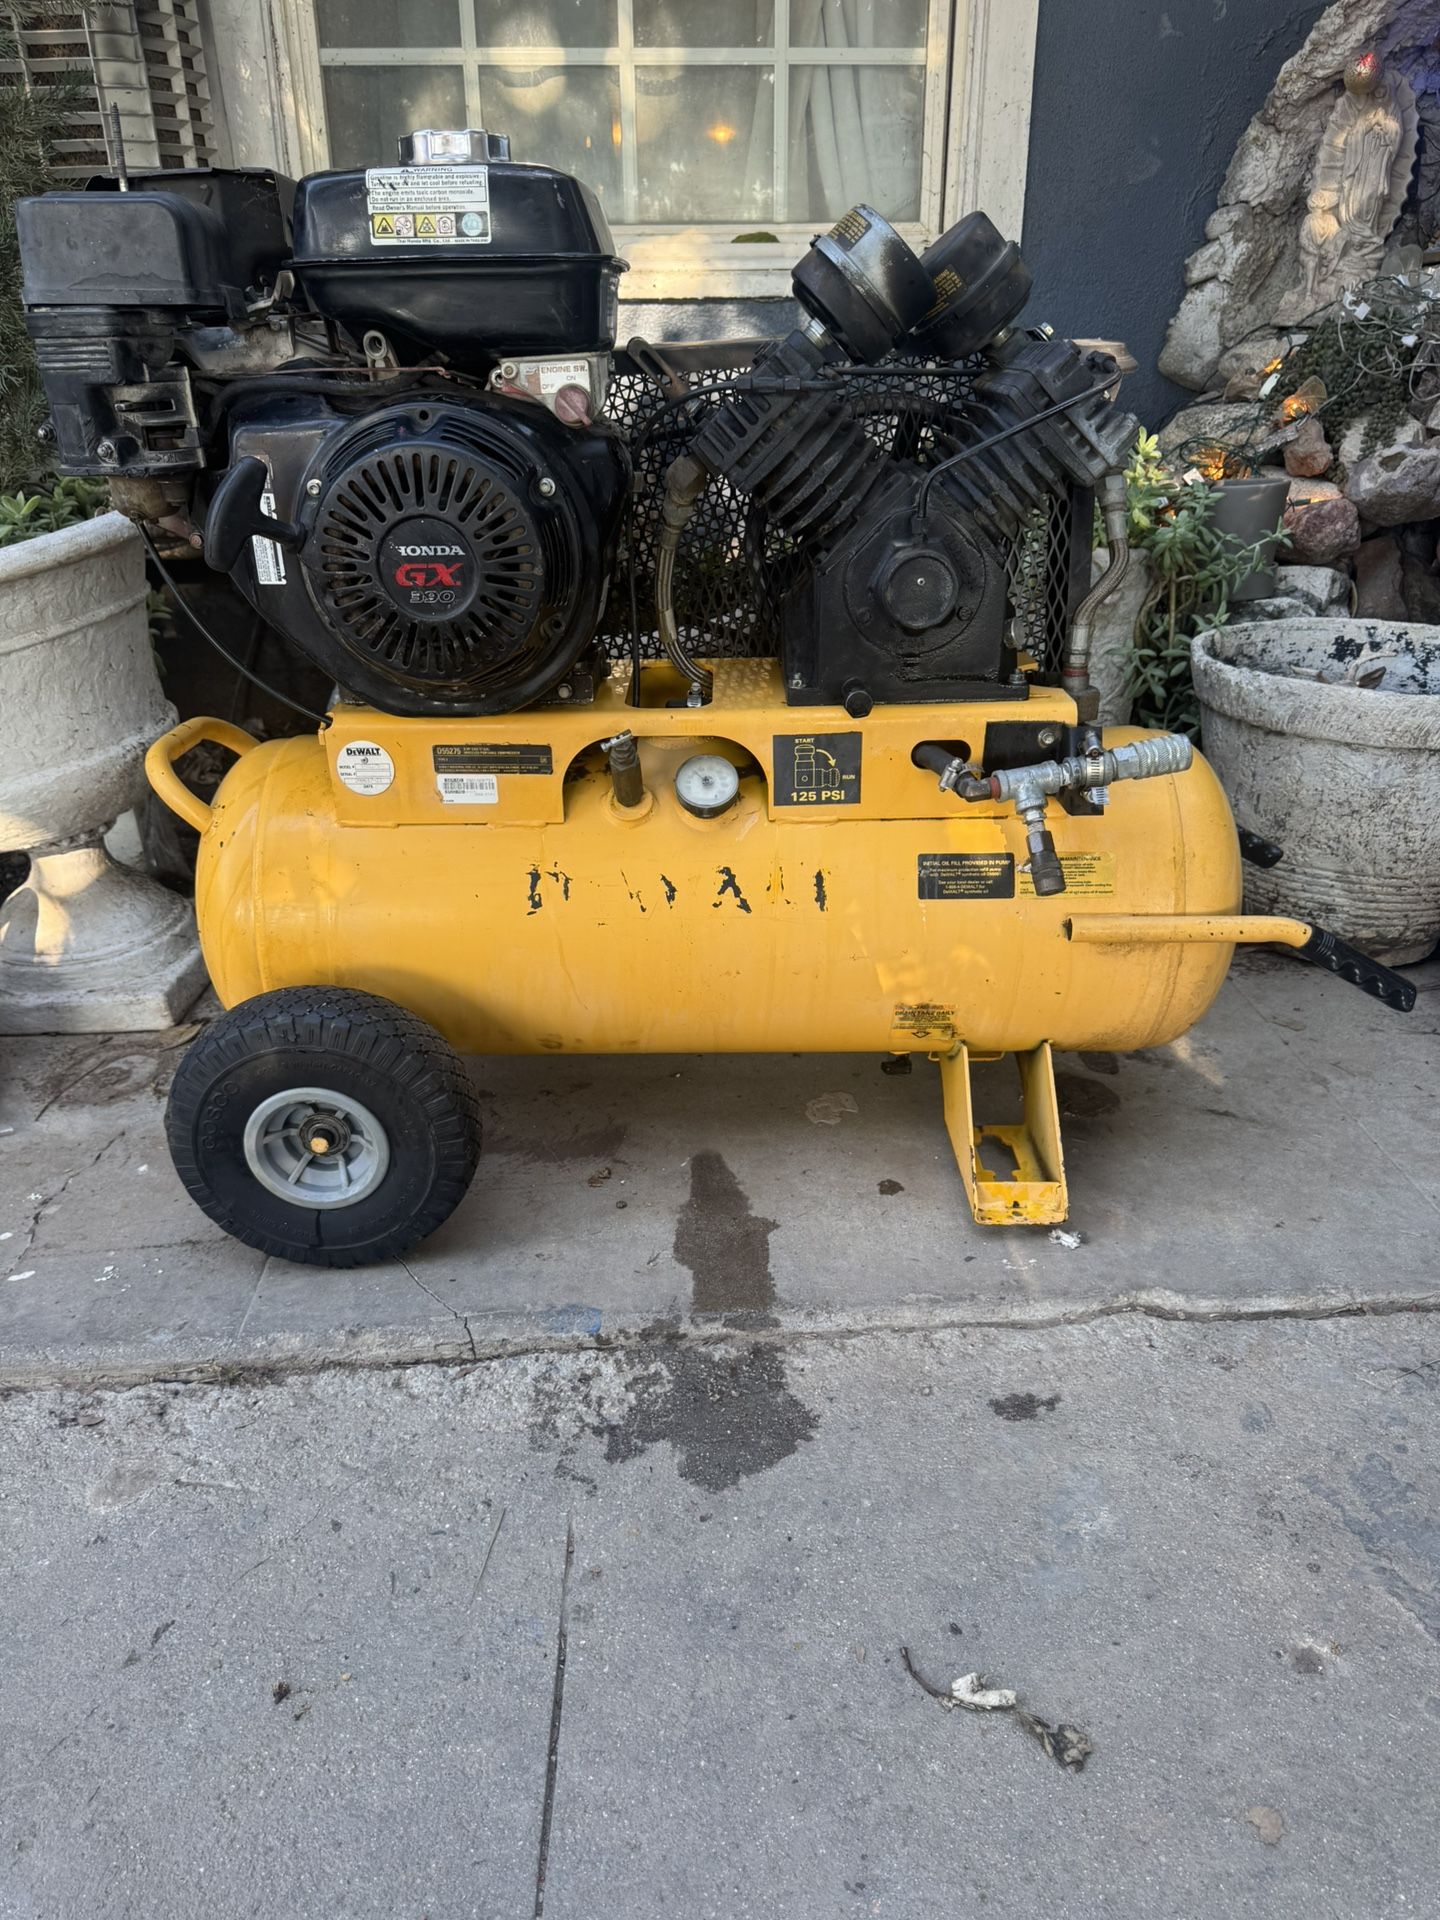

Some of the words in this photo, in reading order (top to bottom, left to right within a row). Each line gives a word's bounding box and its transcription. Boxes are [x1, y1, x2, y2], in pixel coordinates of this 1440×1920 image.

[395, 563, 464, 586] GX
[791, 792, 816, 801] 125
[822, 790, 845, 800] PSI
